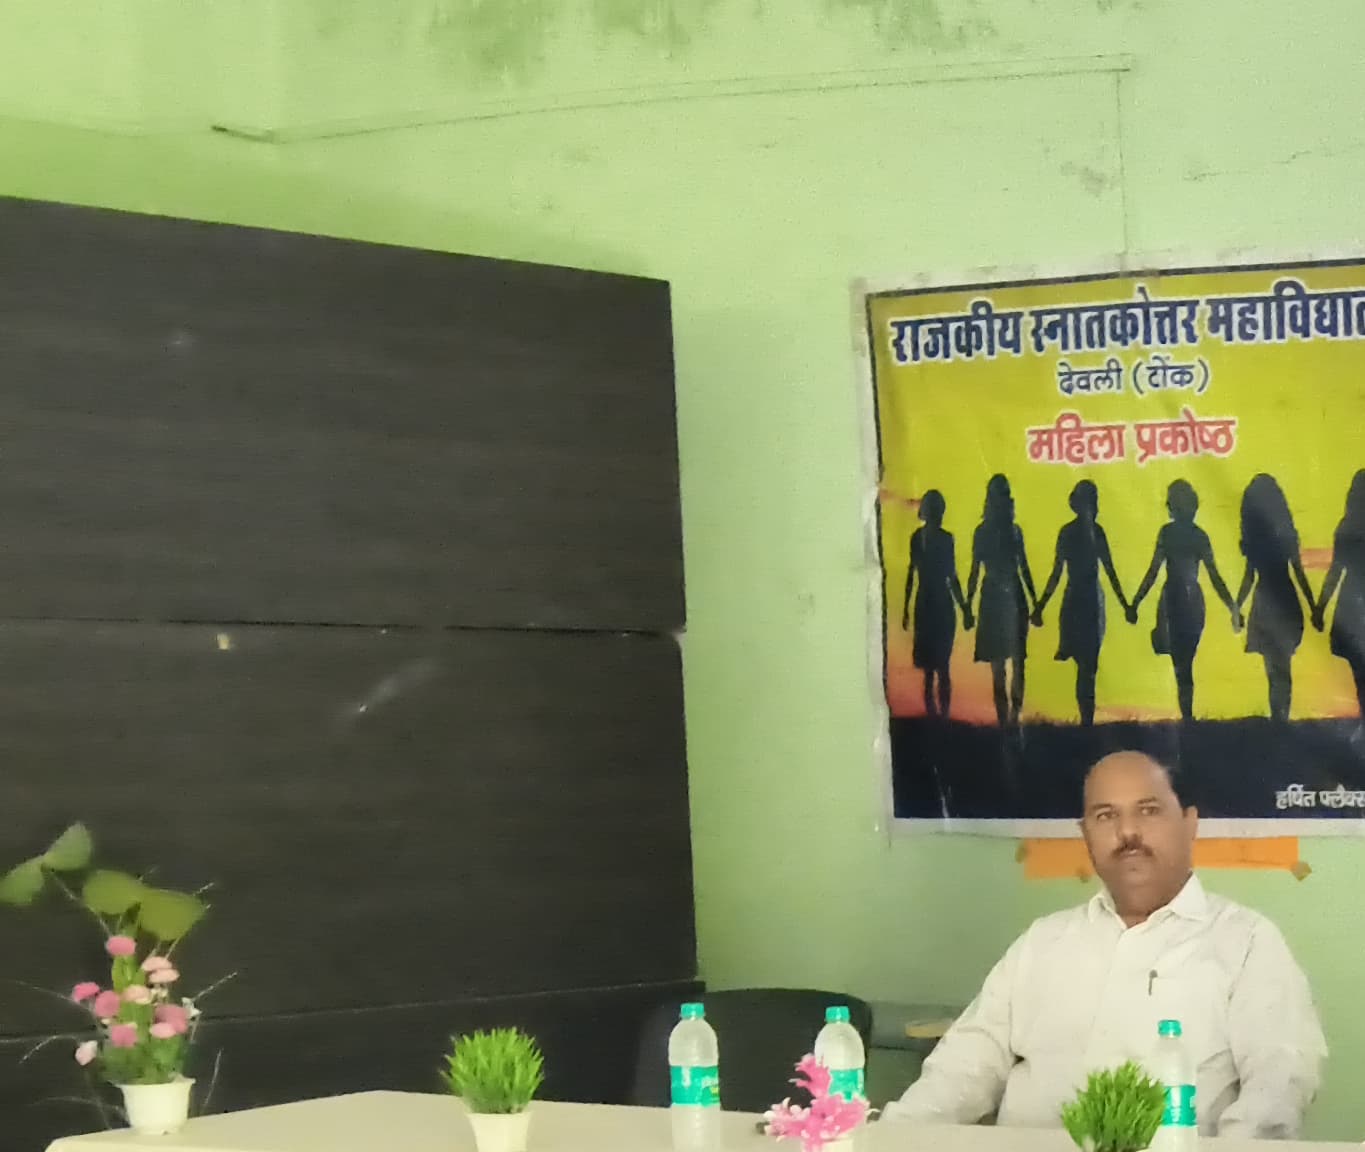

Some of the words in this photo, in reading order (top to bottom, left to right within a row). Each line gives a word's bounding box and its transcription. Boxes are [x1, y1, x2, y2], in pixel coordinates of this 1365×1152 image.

[890, 301, 1024, 362] राजकीय
[1030, 287, 1201, 354] स्नातकोत्तर
[1058, 361, 1123, 394] देवली
[1133, 356, 1209, 394] (टोंक)
[1028, 413, 1125, 463] महिला
[1136, 409, 1236, 463] प्रकोष्ठ
